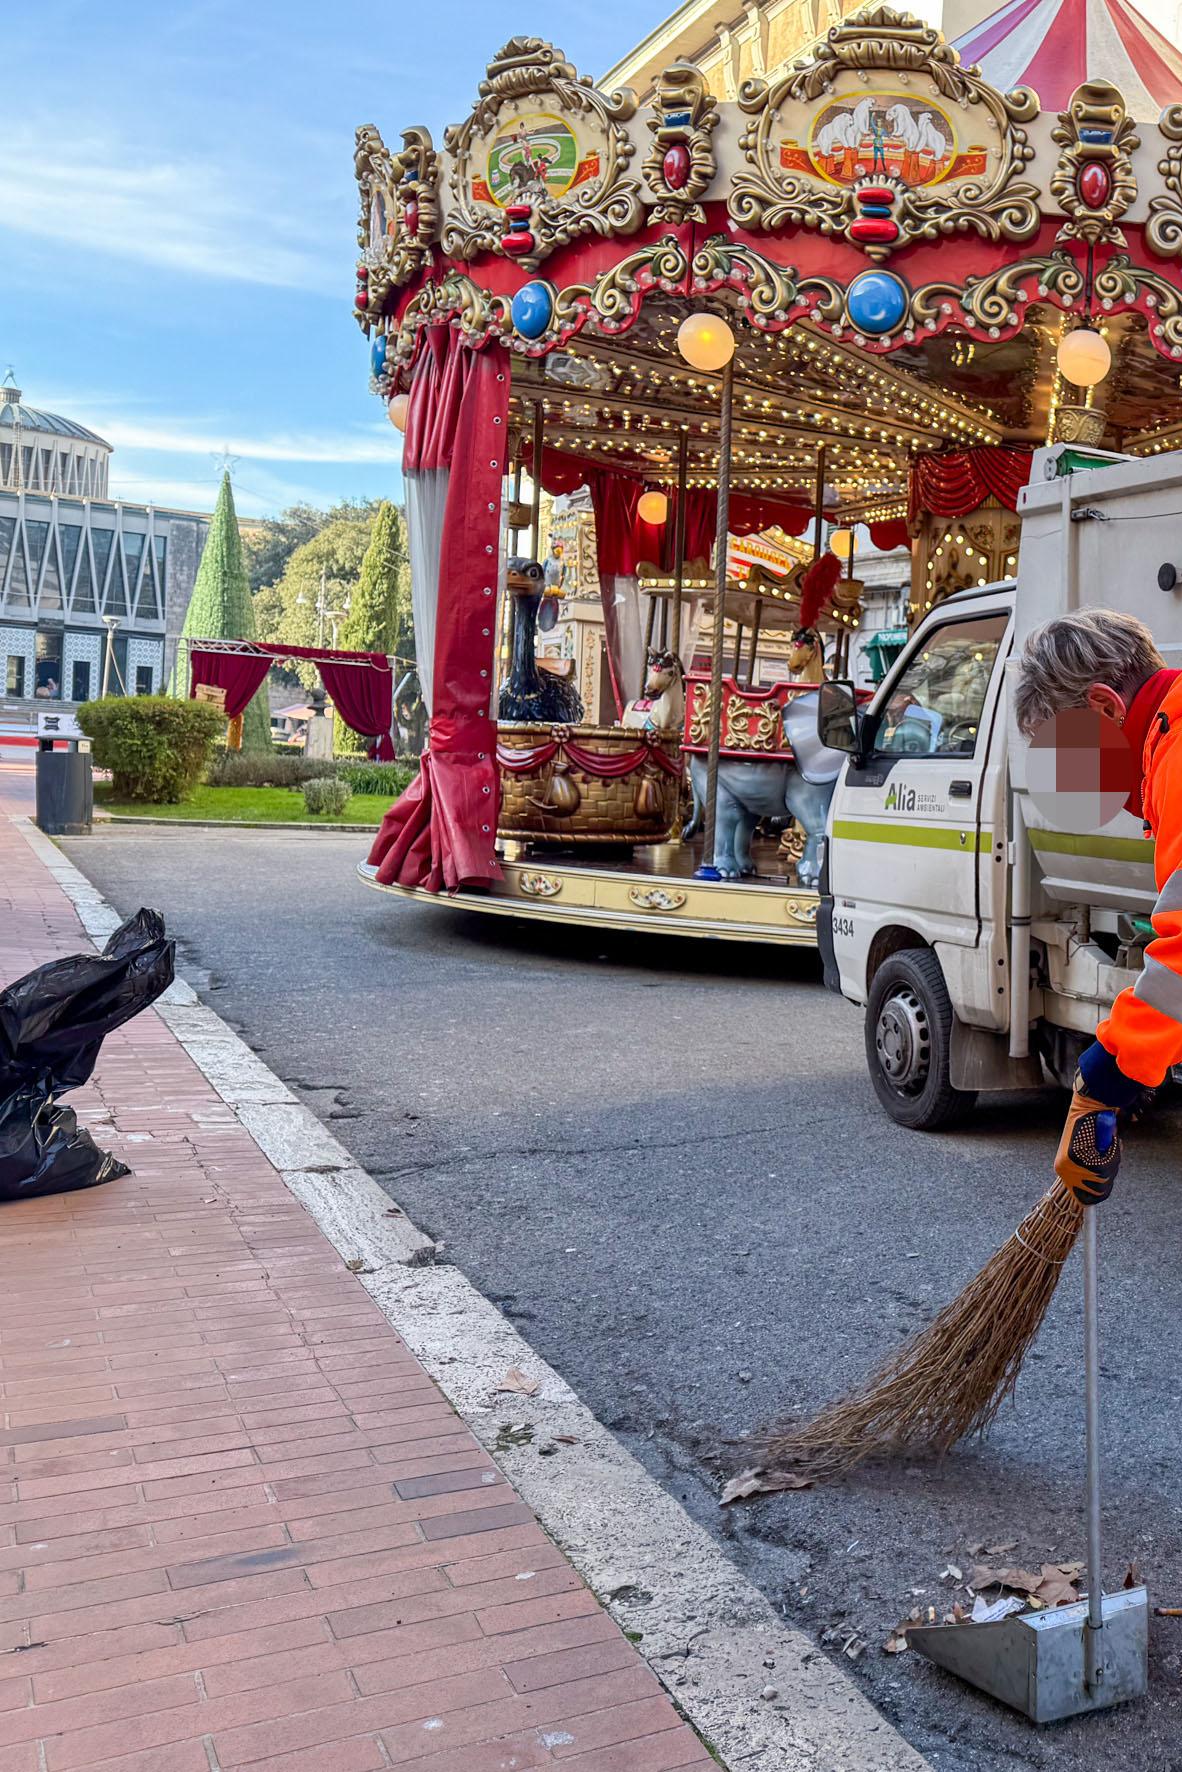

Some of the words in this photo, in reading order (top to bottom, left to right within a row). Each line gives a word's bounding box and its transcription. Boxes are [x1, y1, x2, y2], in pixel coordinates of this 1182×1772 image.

[884, 782, 916, 811] Alia
[917, 794, 936, 803] SERVIZI
[832, 916, 854, 938] 3434
